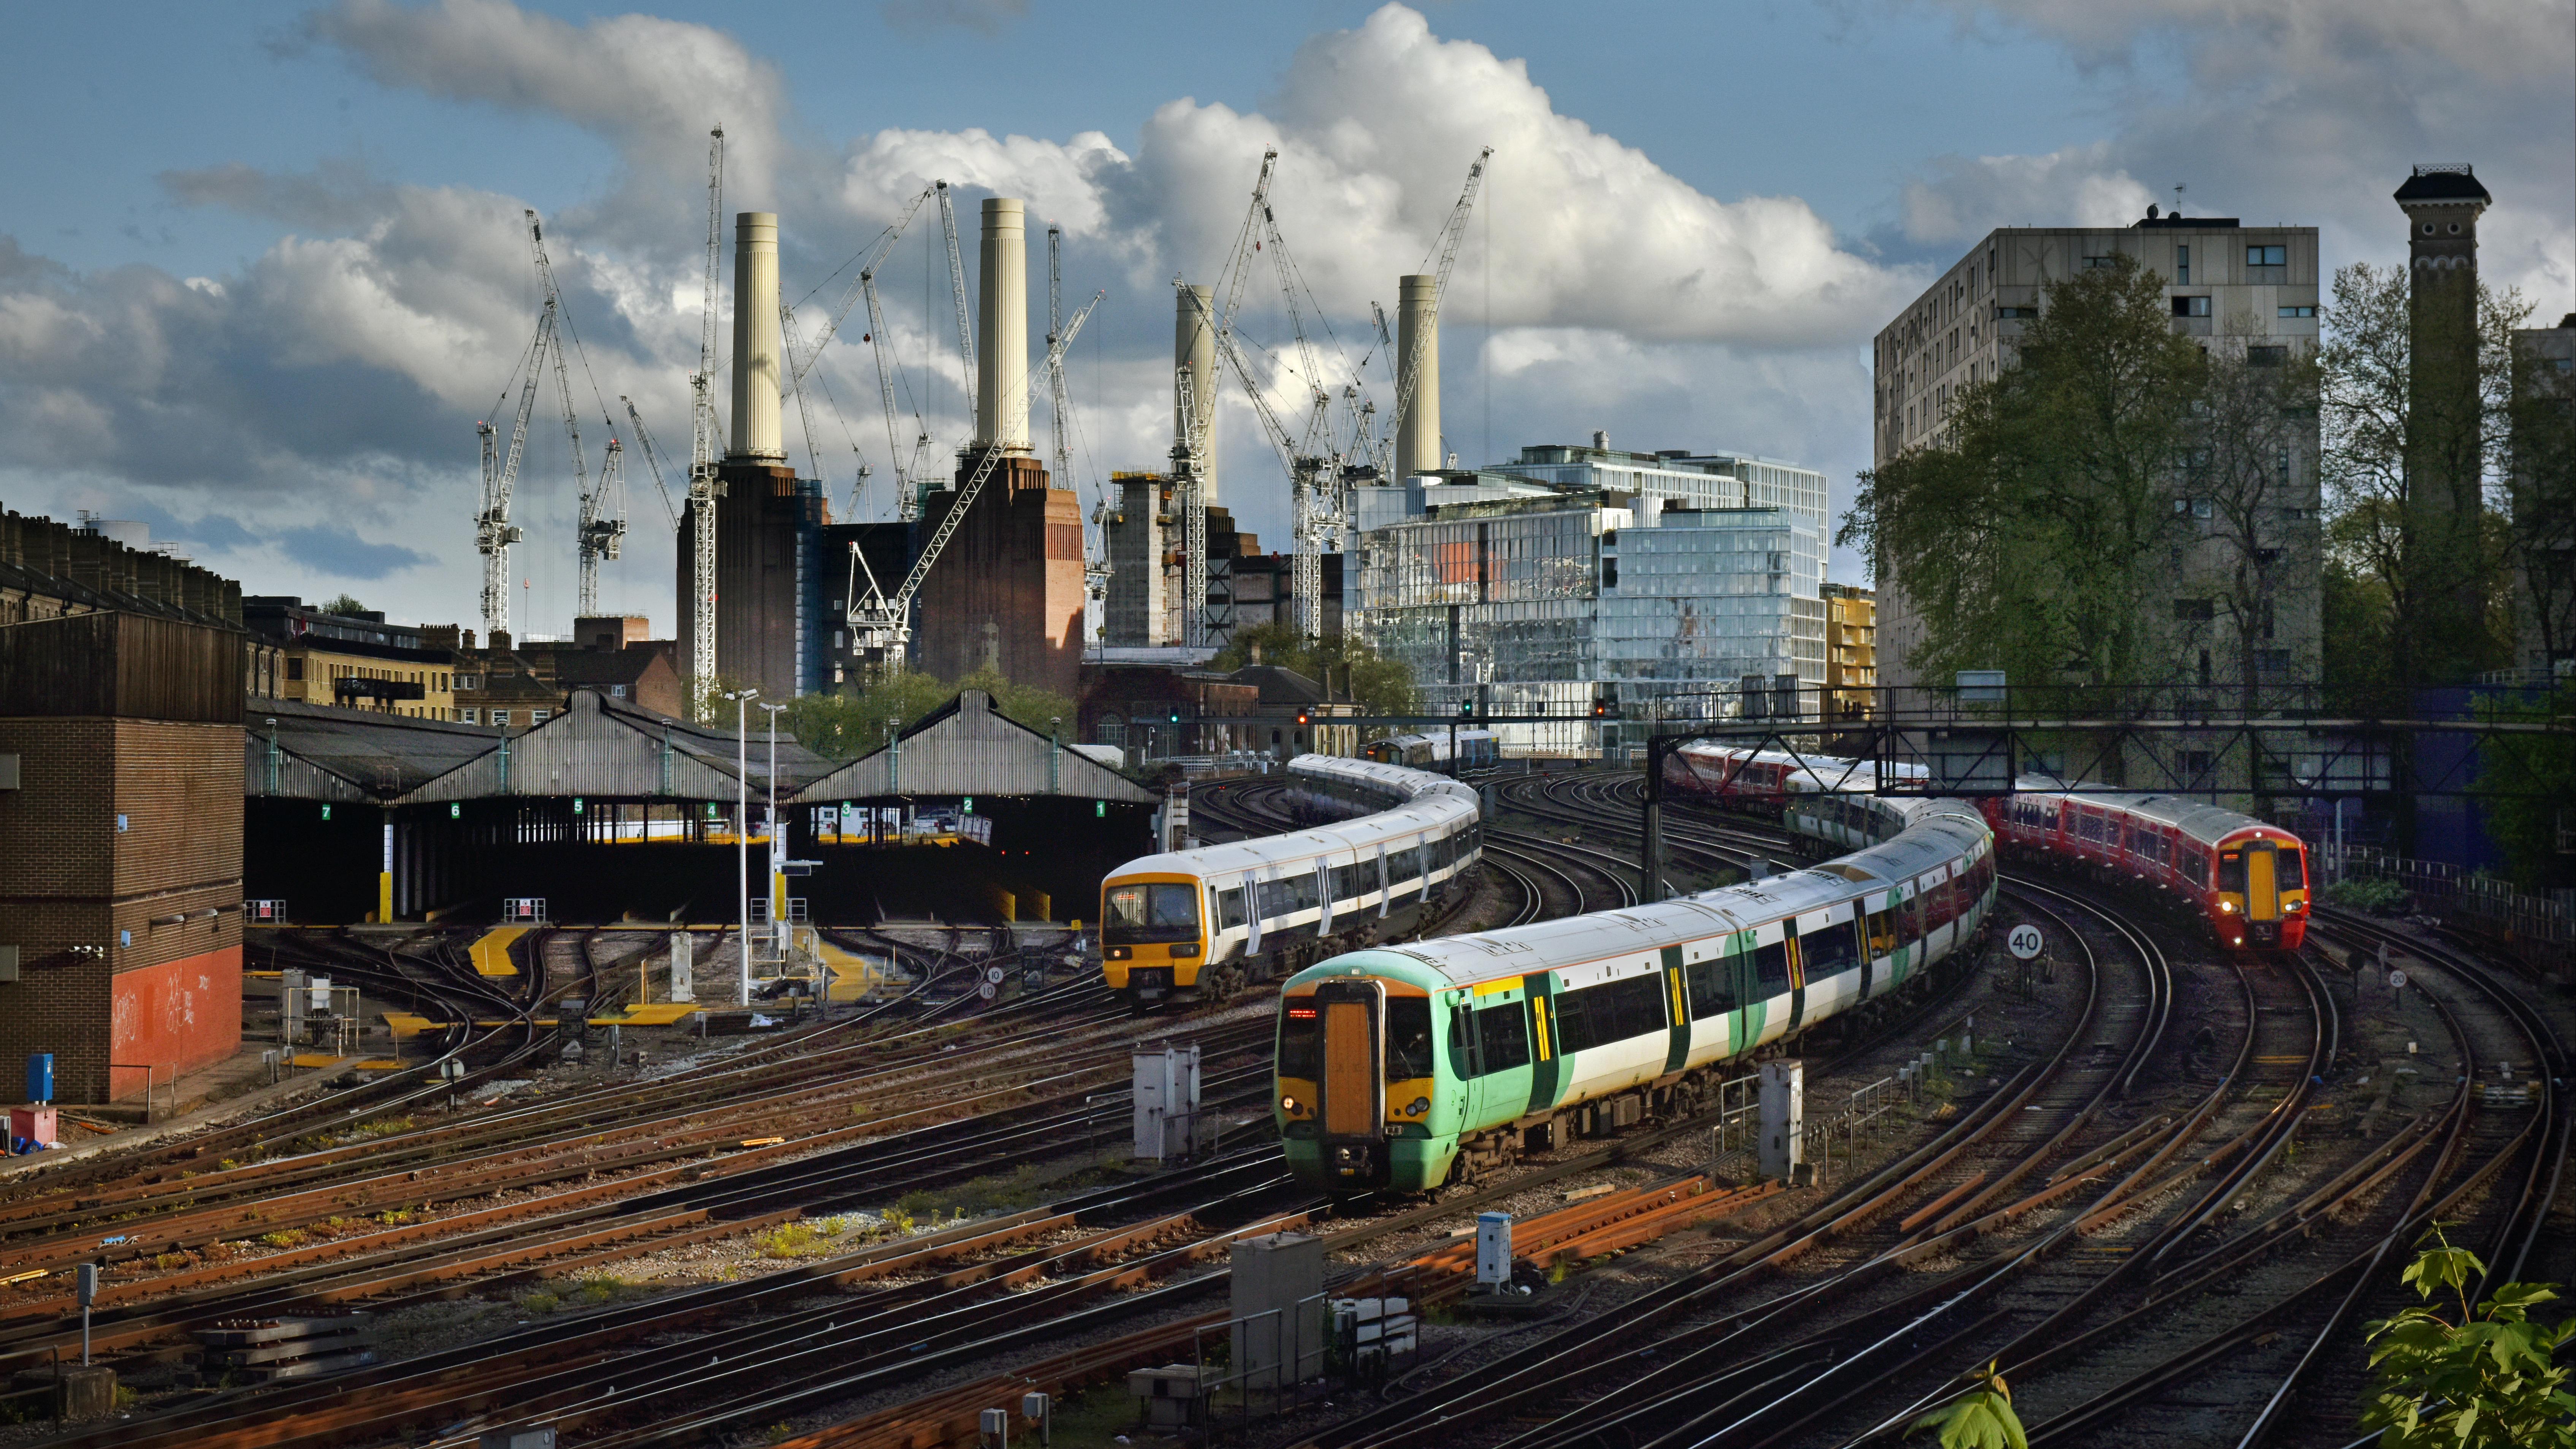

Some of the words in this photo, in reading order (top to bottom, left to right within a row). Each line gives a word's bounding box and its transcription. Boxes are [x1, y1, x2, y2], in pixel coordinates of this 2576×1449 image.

[574, 801, 582, 811] 5
[843, 804, 850, 814] 3
[964, 800, 972, 810] 2
[1097, 804, 1103, 814] 1
[322, 807, 330, 817] 7
[452, 805, 460, 816] 6
[708, 806, 715, 815] 4
[2013, 933, 2038, 950] 40
[2393, 975, 2405, 983] 20
[984, 987, 993, 995] 10
